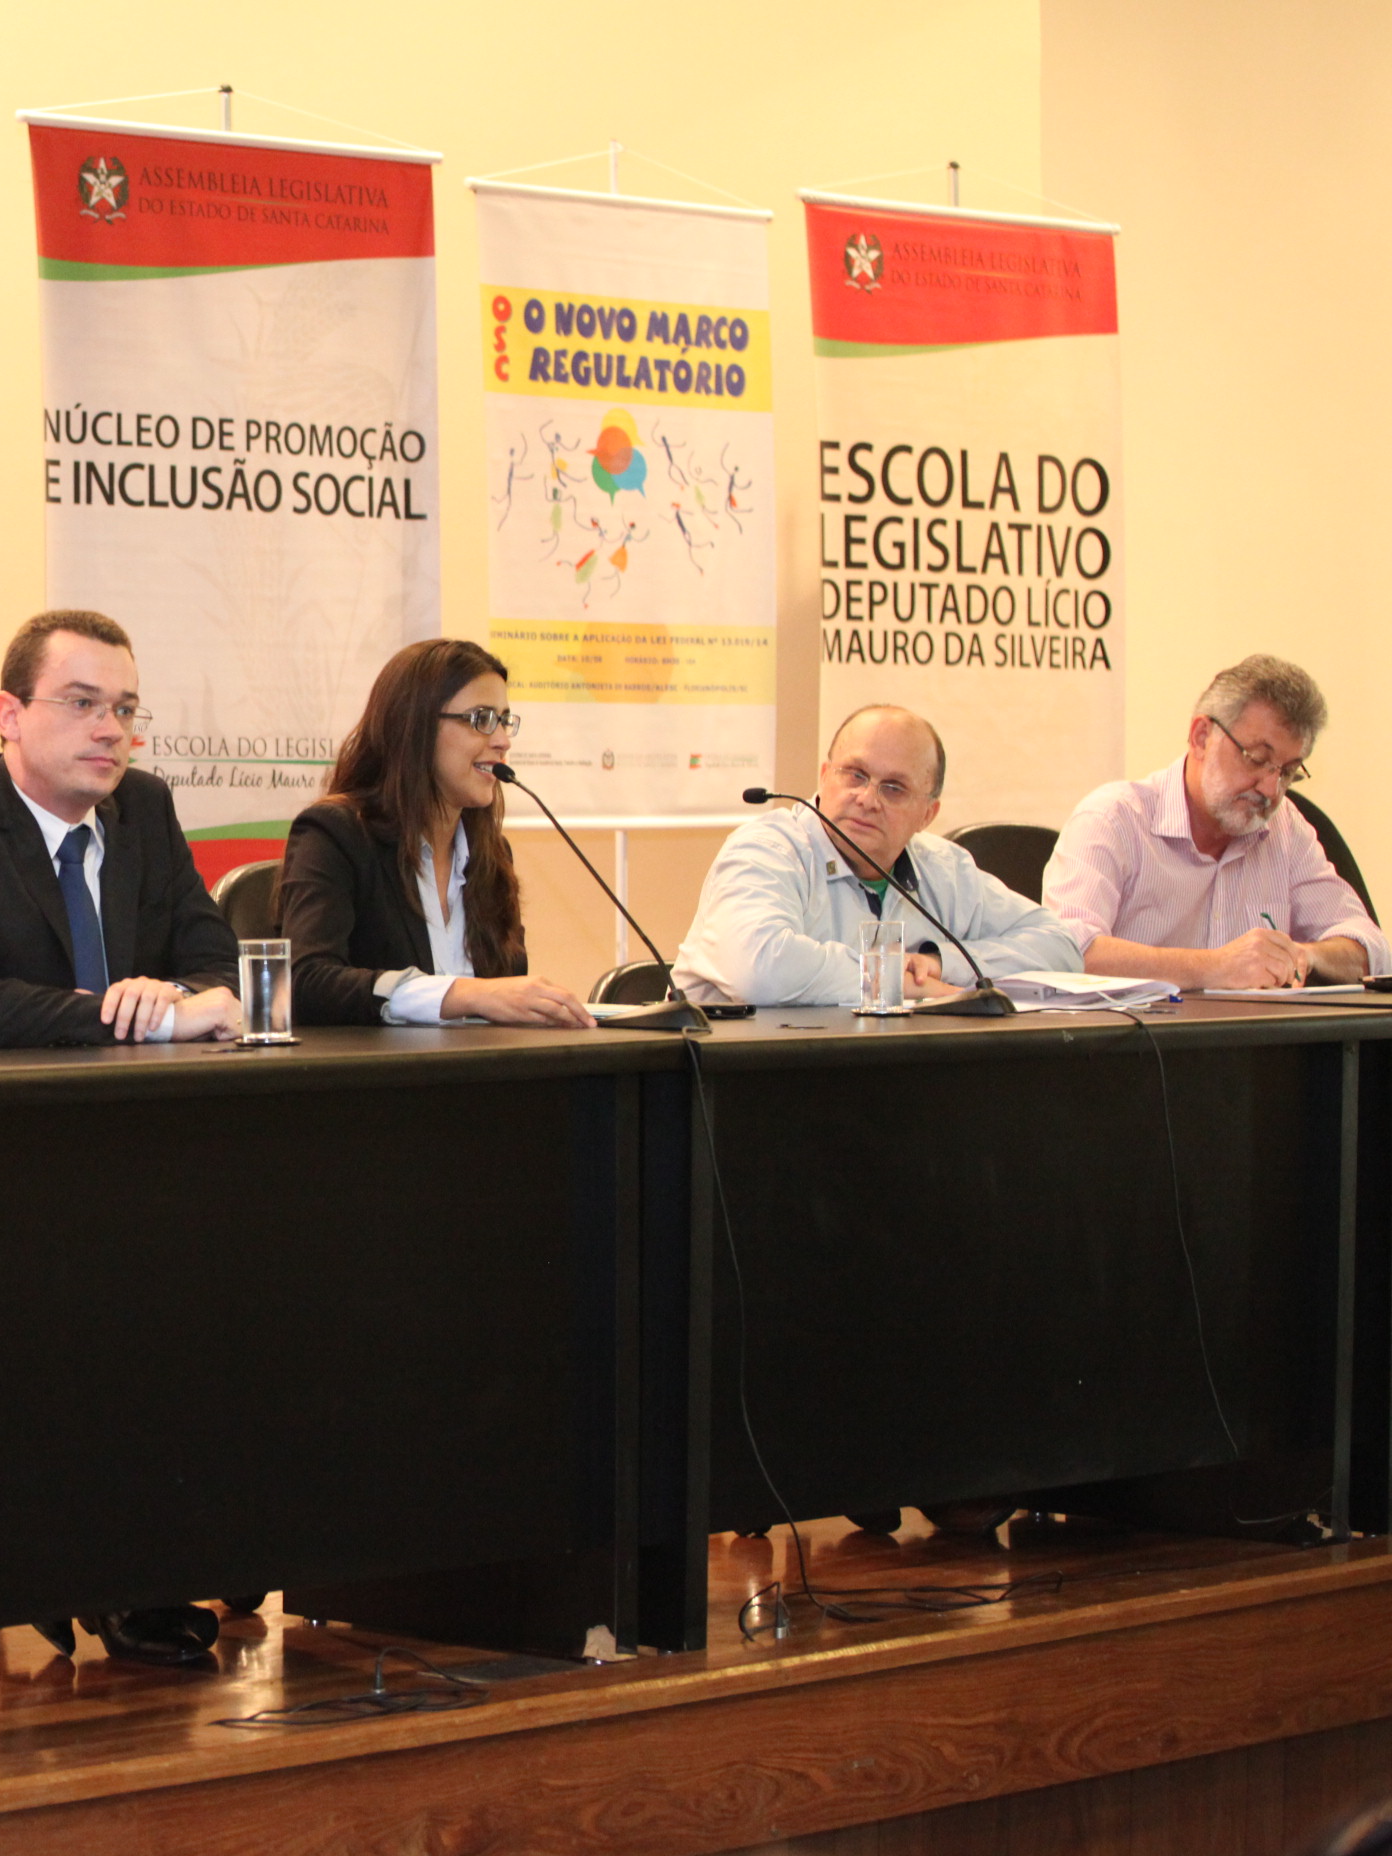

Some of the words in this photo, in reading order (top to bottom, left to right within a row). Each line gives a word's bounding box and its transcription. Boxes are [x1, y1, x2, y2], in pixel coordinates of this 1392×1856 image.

[139, 166, 262, 197] ASSEMBLEIA
[269, 177, 389, 208] LEGISLATIVA
[139, 197, 164, 214] DO
[170, 199, 232, 220] ESTADO
[237, 205, 257, 222] DE
[262, 207, 310, 228] SANTA
[315, 212, 390, 236] CATARINA
[523, 297, 546, 335] O
[554, 301, 637, 343] NOVO
[645, 310, 750, 352] MARCO
[528, 345, 746, 398] REGULATÓRIO
[43, 402, 180, 450] NÚCLEO
[191, 416, 236, 453] DE
[245, 419, 427, 470] PROMOÇÃO
[45, 458, 62, 504] E
[72, 458, 283, 514] INCLUSÃO
[292, 470, 429, 521] SOCIAL
[819, 440, 1021, 513] ESCOLA
[1037, 454, 1110, 518] DO
[820, 512, 1112, 581] LEGISLATIVO
[821, 578, 1016, 627] DEPUTADO
[1027, 578, 1113, 630] LÍCIO
[821, 628, 935, 666] MAURO
[944, 631, 986, 667] DA
[994, 632, 1112, 671] SILVEIRA
[153, 734, 230, 758] ESCOLA
[237, 736, 267, 758] DO
[275, 737, 335, 759] LEGISL
[267, 767, 316, 790] Mauro
